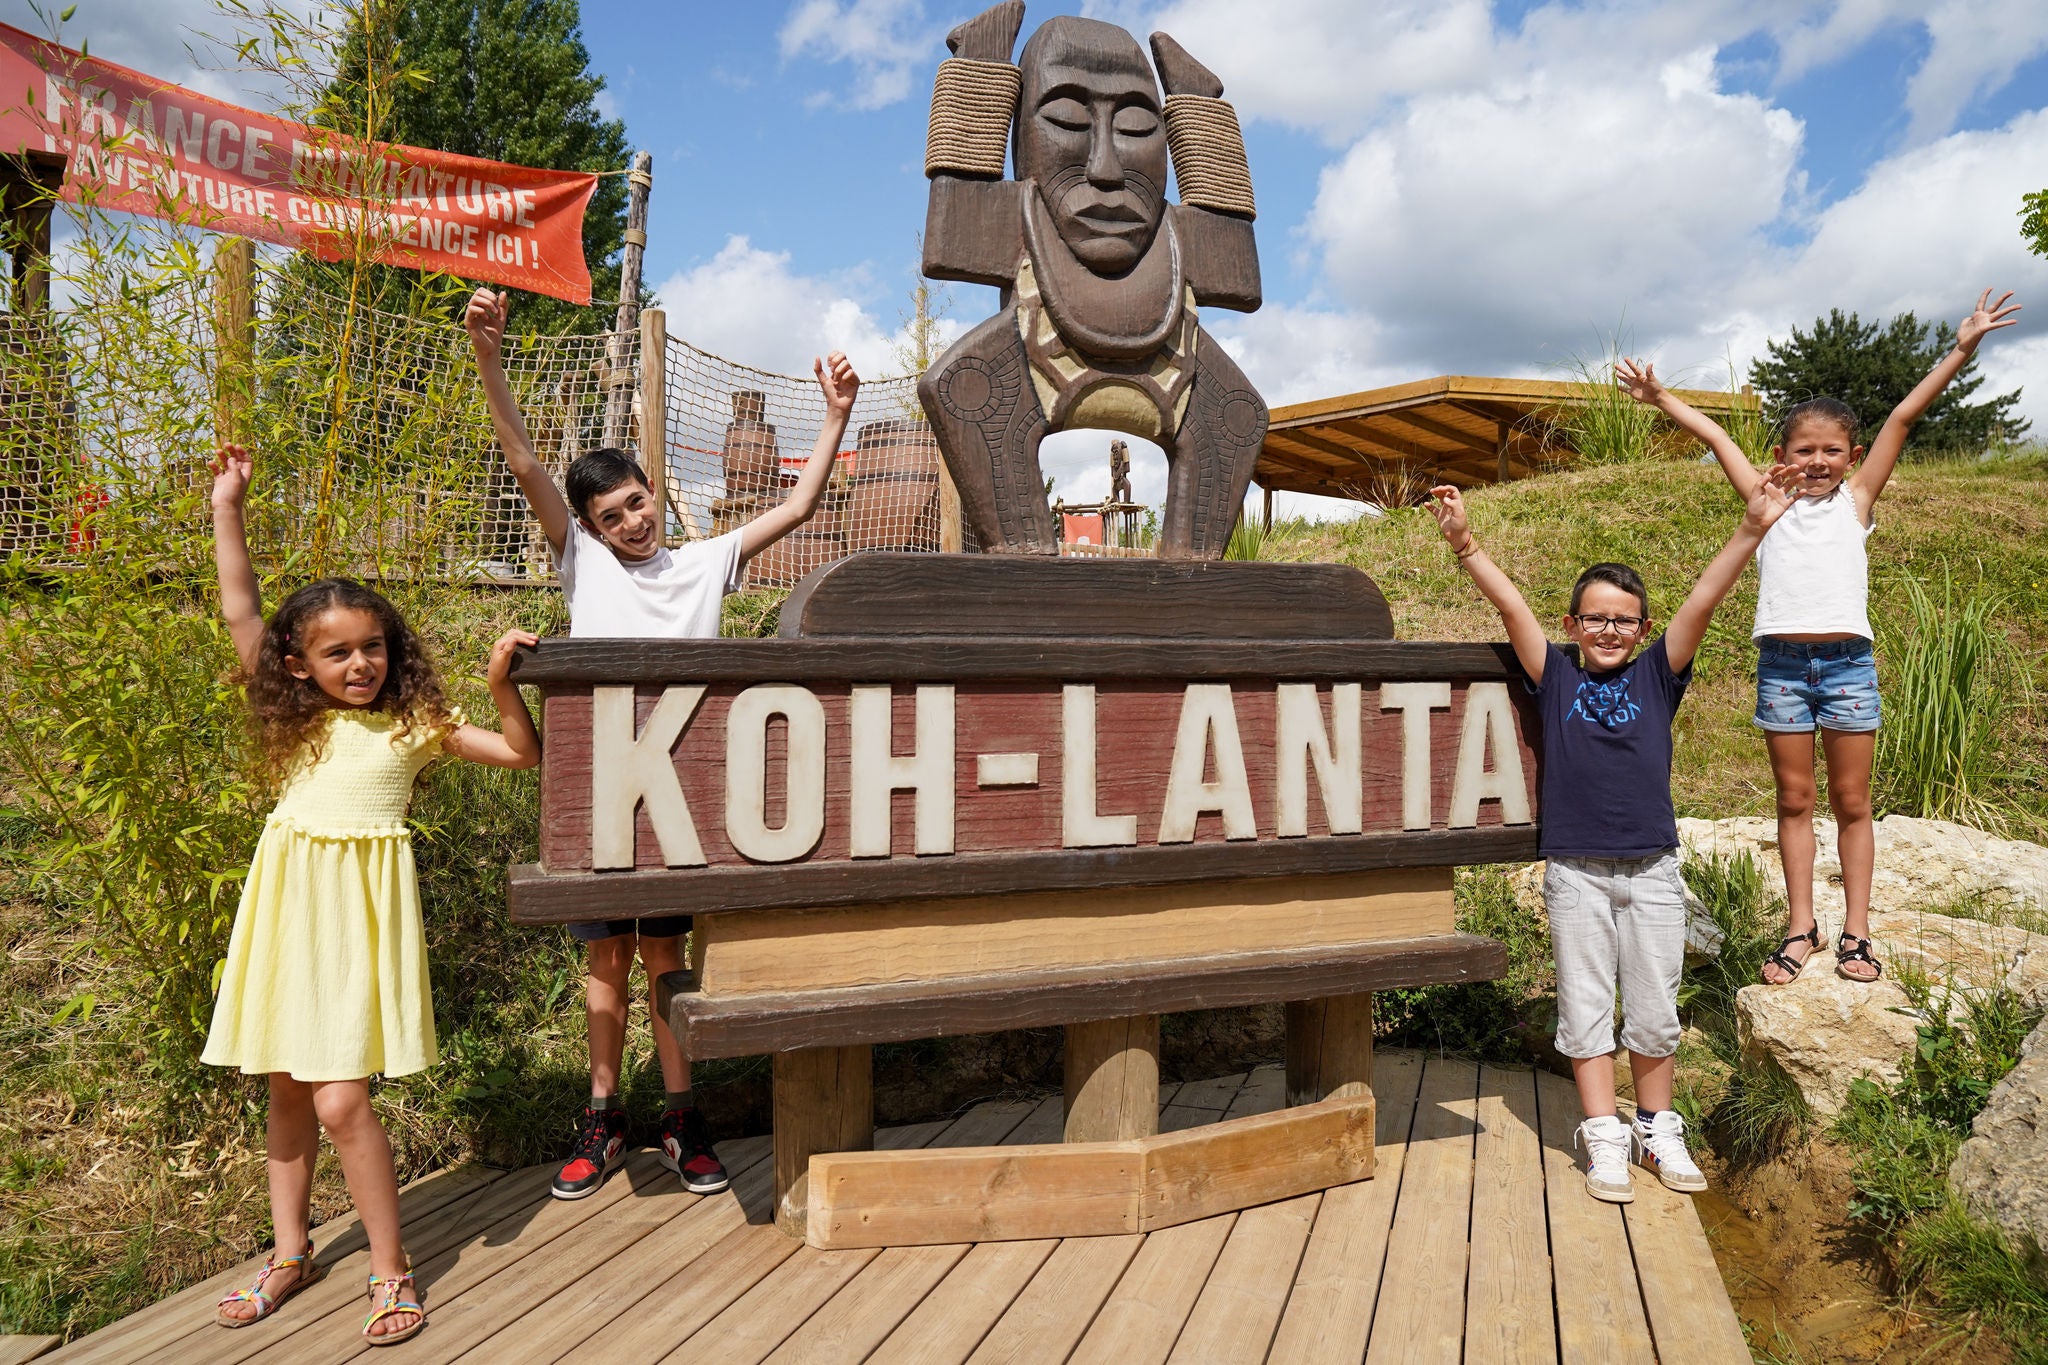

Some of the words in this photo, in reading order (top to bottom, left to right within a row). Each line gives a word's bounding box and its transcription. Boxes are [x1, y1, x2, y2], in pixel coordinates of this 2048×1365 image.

[45, 72, 274, 180] FRANCE
[288, 137, 537, 230] MINIATURE
[287, 196, 479, 259] COMMENCE
[486, 230, 525, 267] ICI
[531, 240, 540, 270] !
[591, 681, 1532, 870] KOH-LANTA
